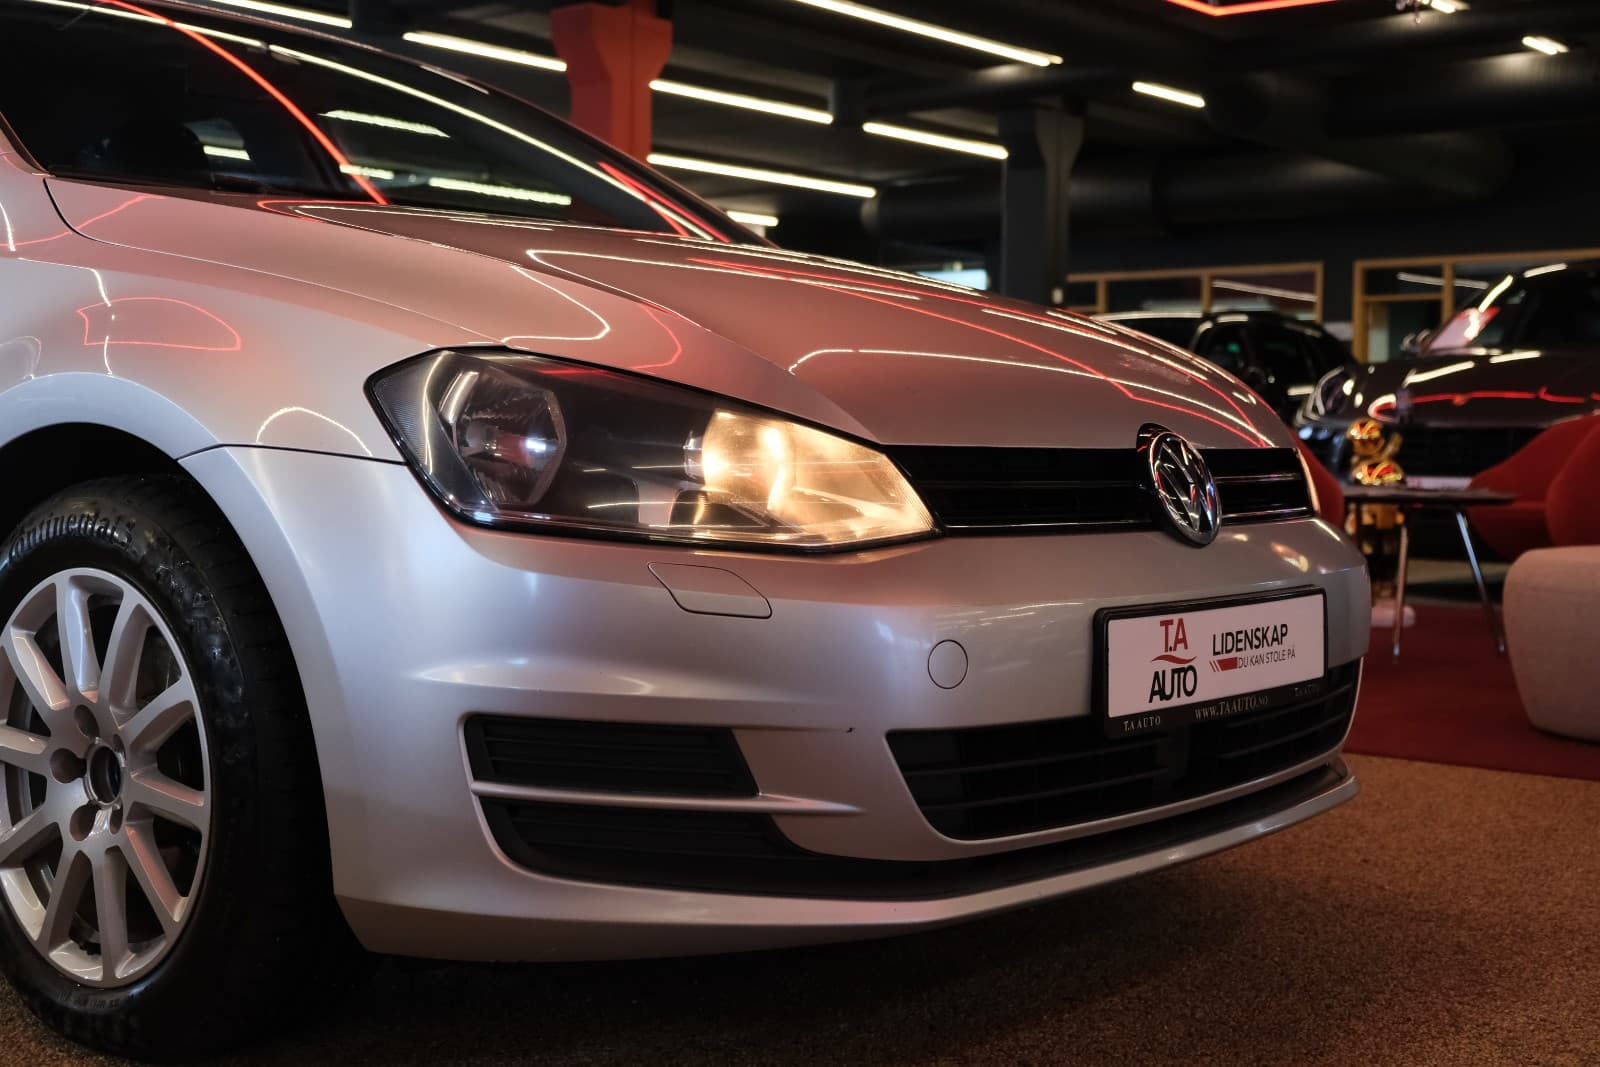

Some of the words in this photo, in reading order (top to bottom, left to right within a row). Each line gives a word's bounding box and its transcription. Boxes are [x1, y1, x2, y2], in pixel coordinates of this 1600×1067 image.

[1159, 617, 1189, 653] T.A
[1212, 623, 1288, 656] LIDENSKAP
[1238, 656, 1249, 669] DU
[1250, 654, 1265, 667] KAN
[1266, 649, 1286, 664] STOLE
[1149, 665, 1198, 703] AUTO
